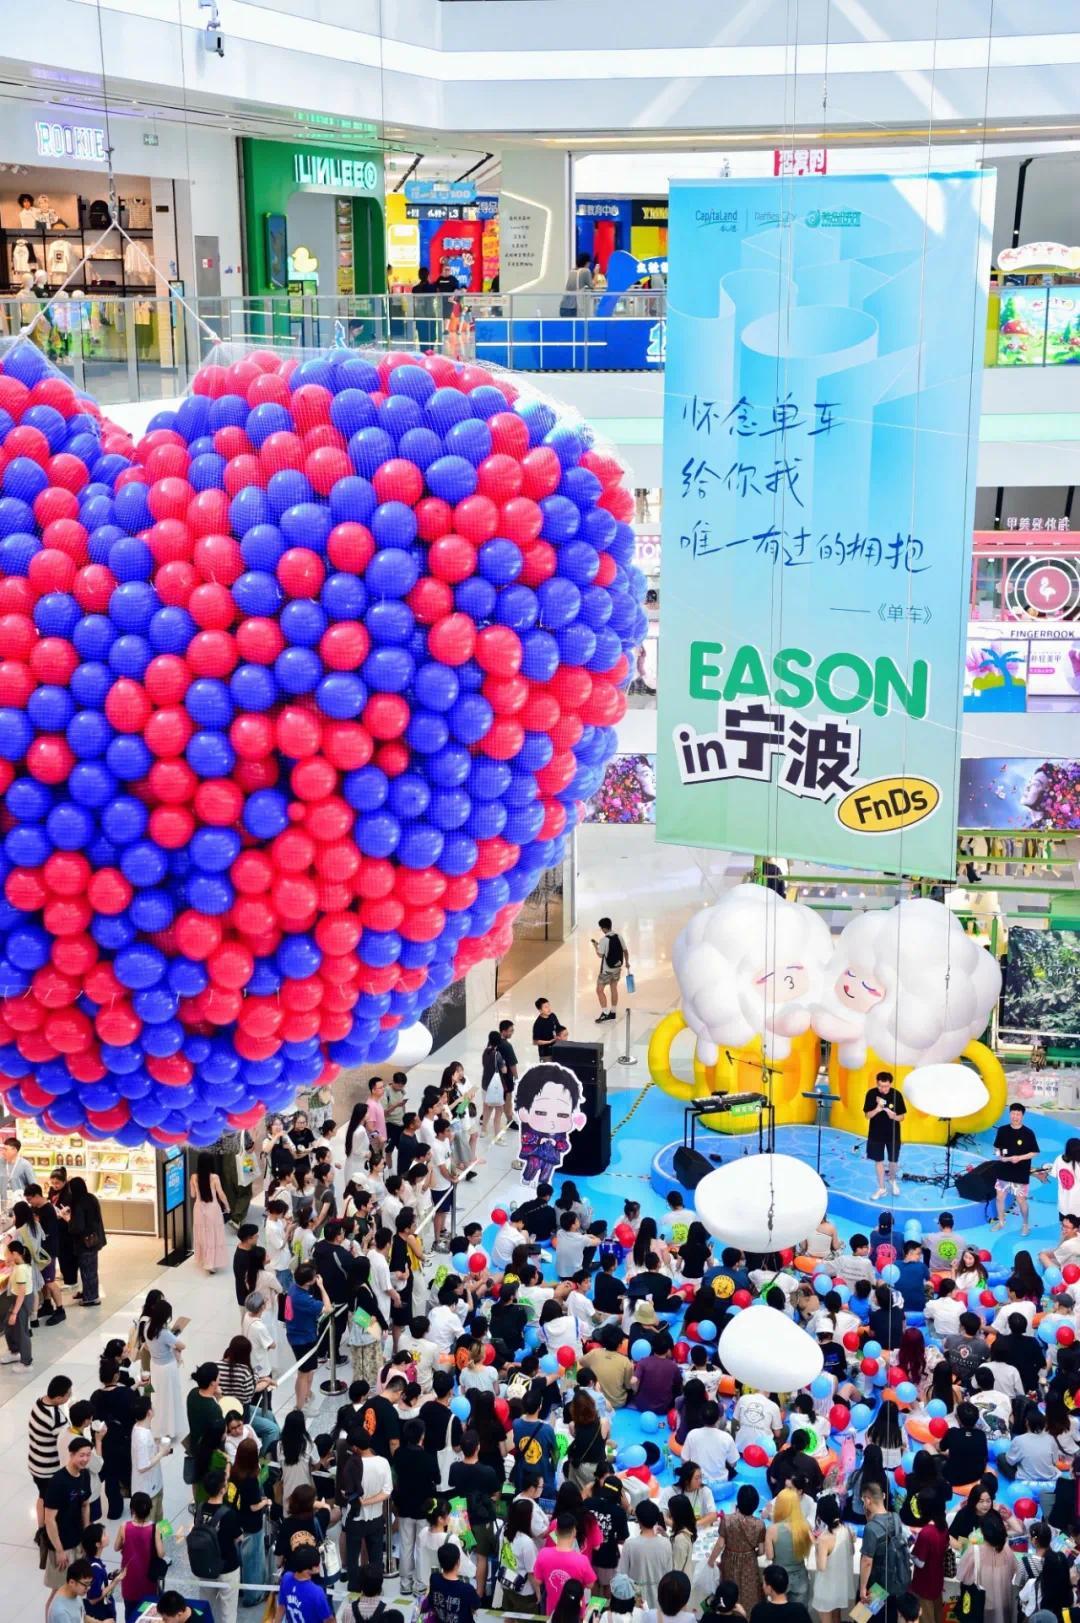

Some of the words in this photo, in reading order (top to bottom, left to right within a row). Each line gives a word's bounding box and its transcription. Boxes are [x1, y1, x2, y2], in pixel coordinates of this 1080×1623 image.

[695, 208, 738, 223] CapitaLand
[683, 392, 845, 441] 怀念单车
[682, 457, 804, 507] 给你我
[680, 520, 932, 573] 唯一有过的拥抱
[689, 641, 928, 719] EASON
[854, 788, 928, 824] FnDs
